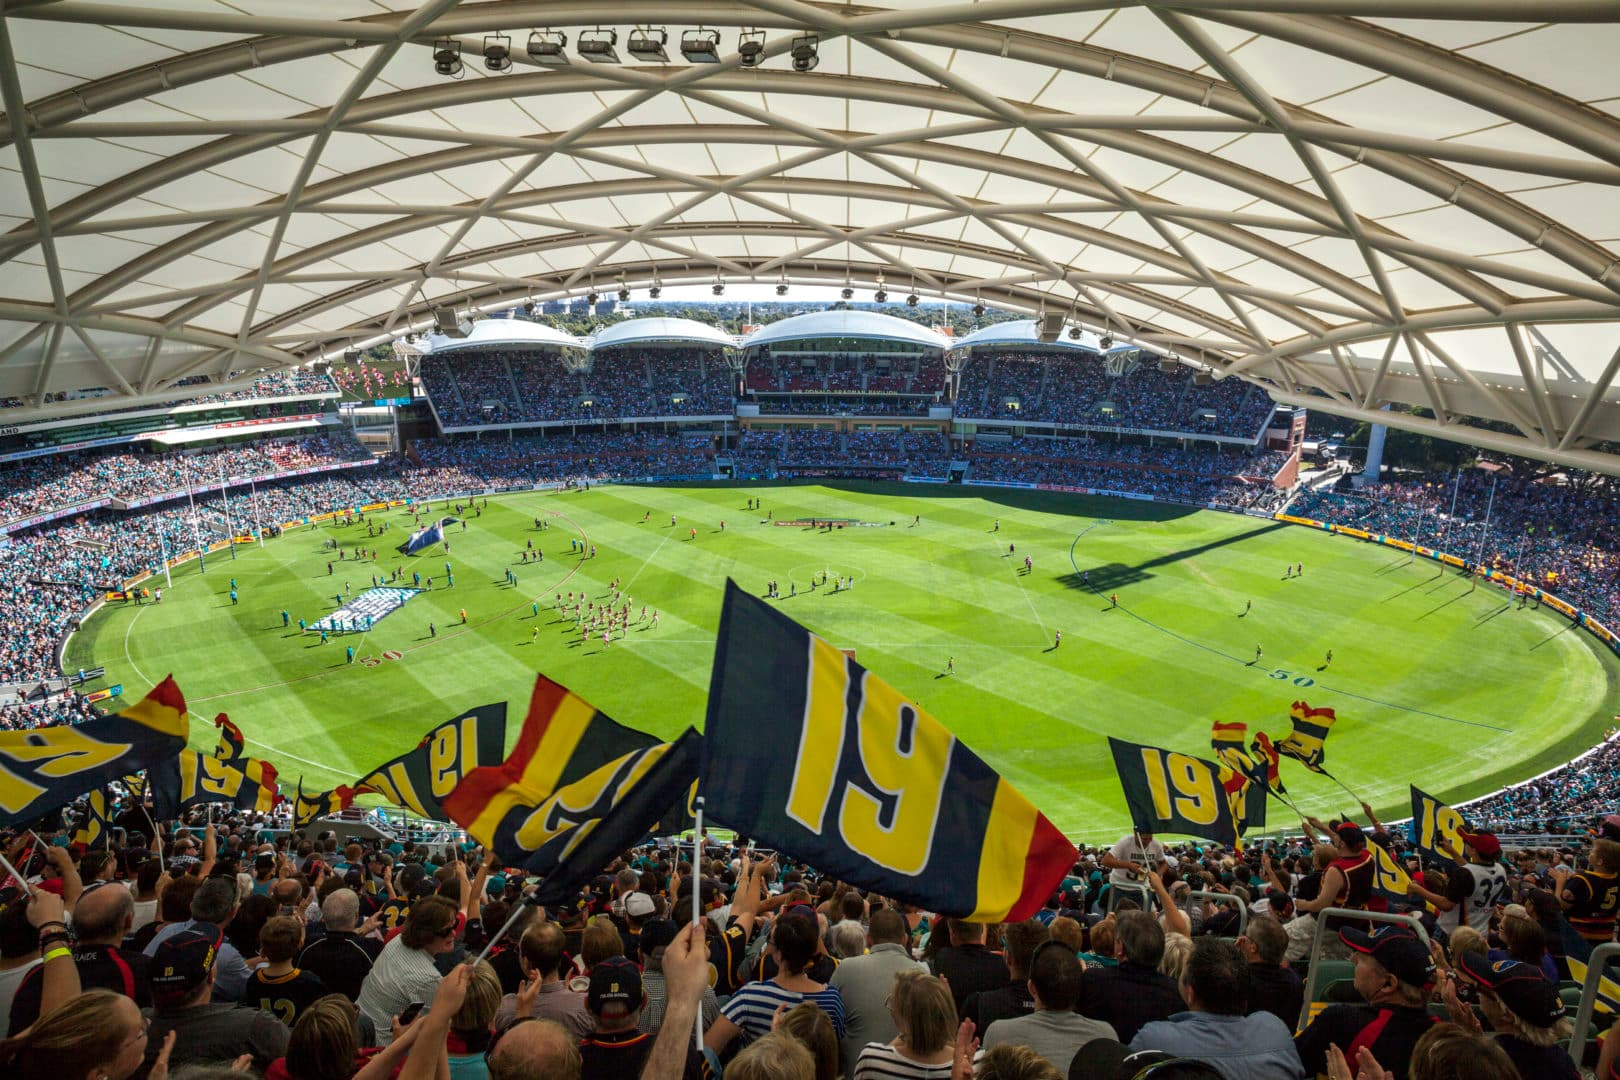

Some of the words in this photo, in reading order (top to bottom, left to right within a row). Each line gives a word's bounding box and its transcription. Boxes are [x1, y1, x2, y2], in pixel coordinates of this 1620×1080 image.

[359, 650, 404, 668] 50
[1267, 669, 1316, 688] 50
[785, 631, 956, 878] 19
[1140, 746, 1220, 826] 19
[1421, 797, 1466, 861] 19
[1473, 875, 1507, 908] 32
[1599, 886, 1619, 910] 5
